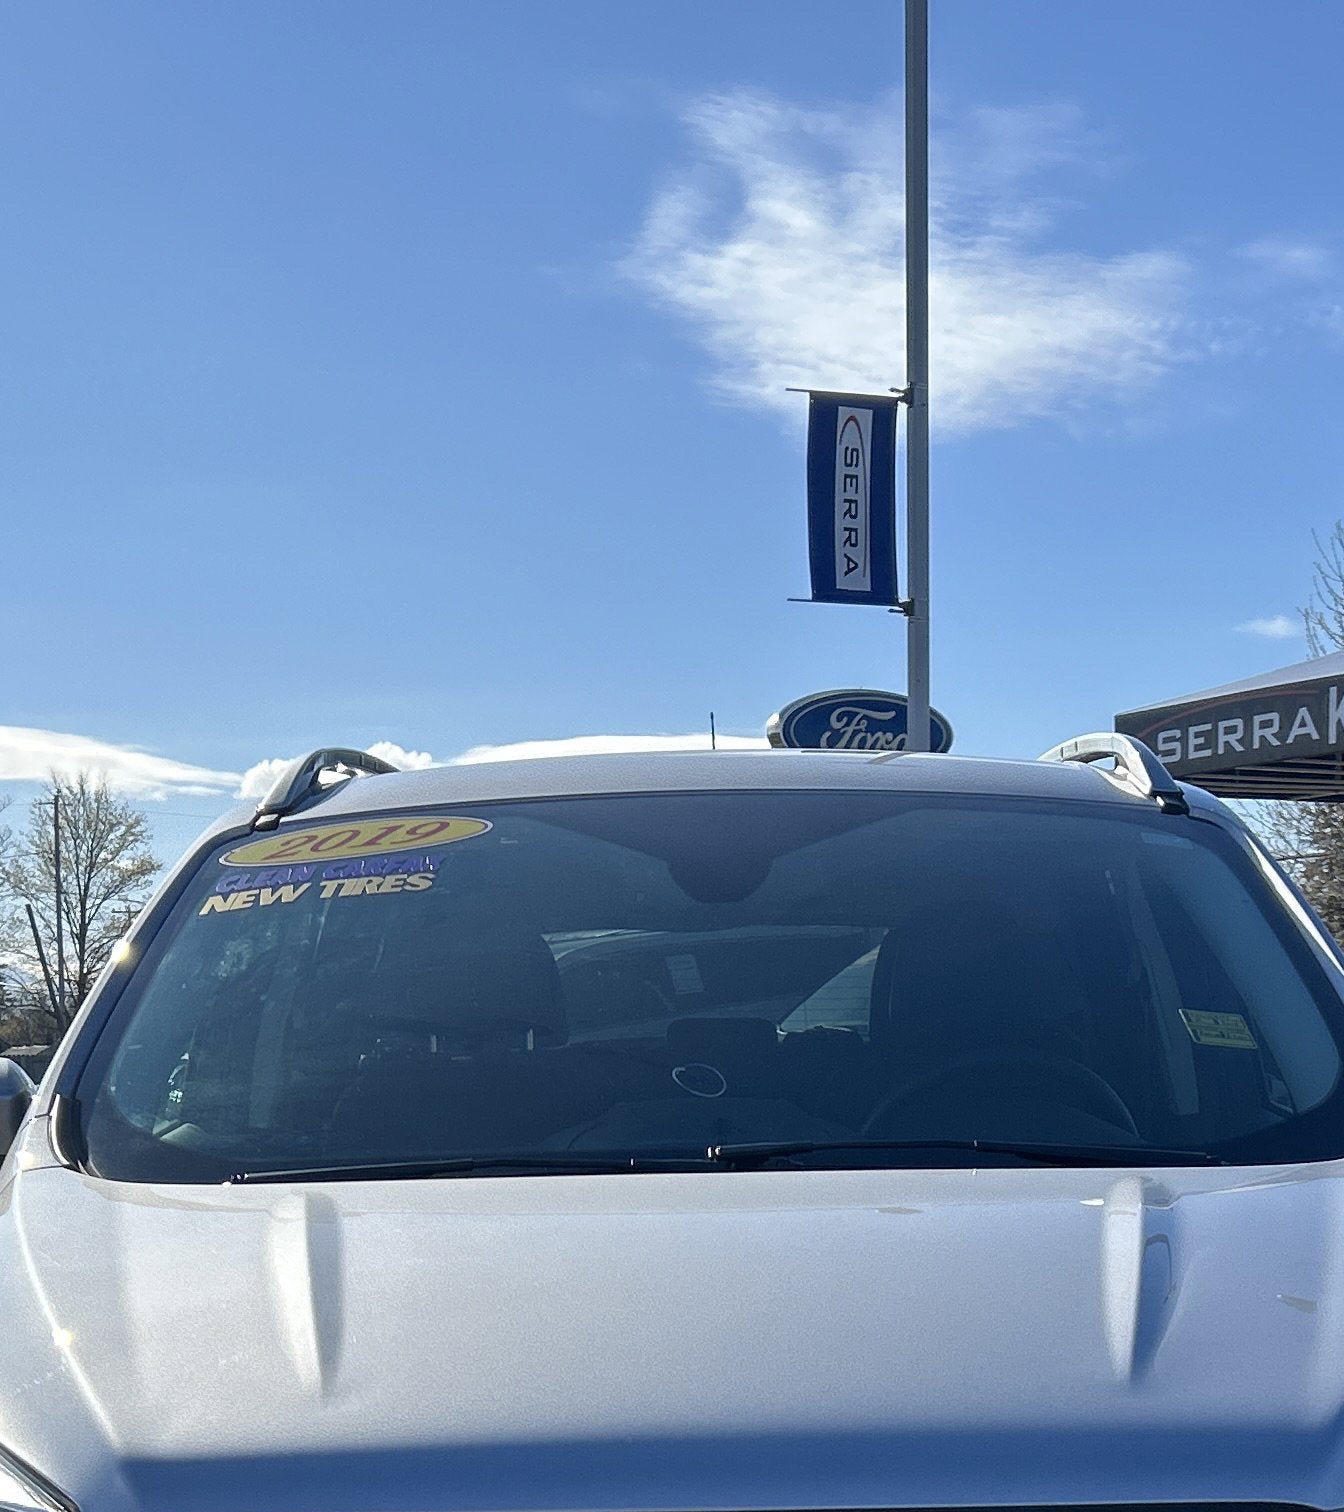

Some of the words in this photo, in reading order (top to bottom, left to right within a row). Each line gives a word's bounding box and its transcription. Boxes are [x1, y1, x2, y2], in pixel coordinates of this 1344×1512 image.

[842, 445, 860, 577] SERRA
[1156, 706, 1320, 764] SERRA
[260, 820, 451, 861] 2019
[199, 882, 312, 916] NEW
[319, 872, 437, 899] TIRES
[215, 864, 317, 893] CLEAN
